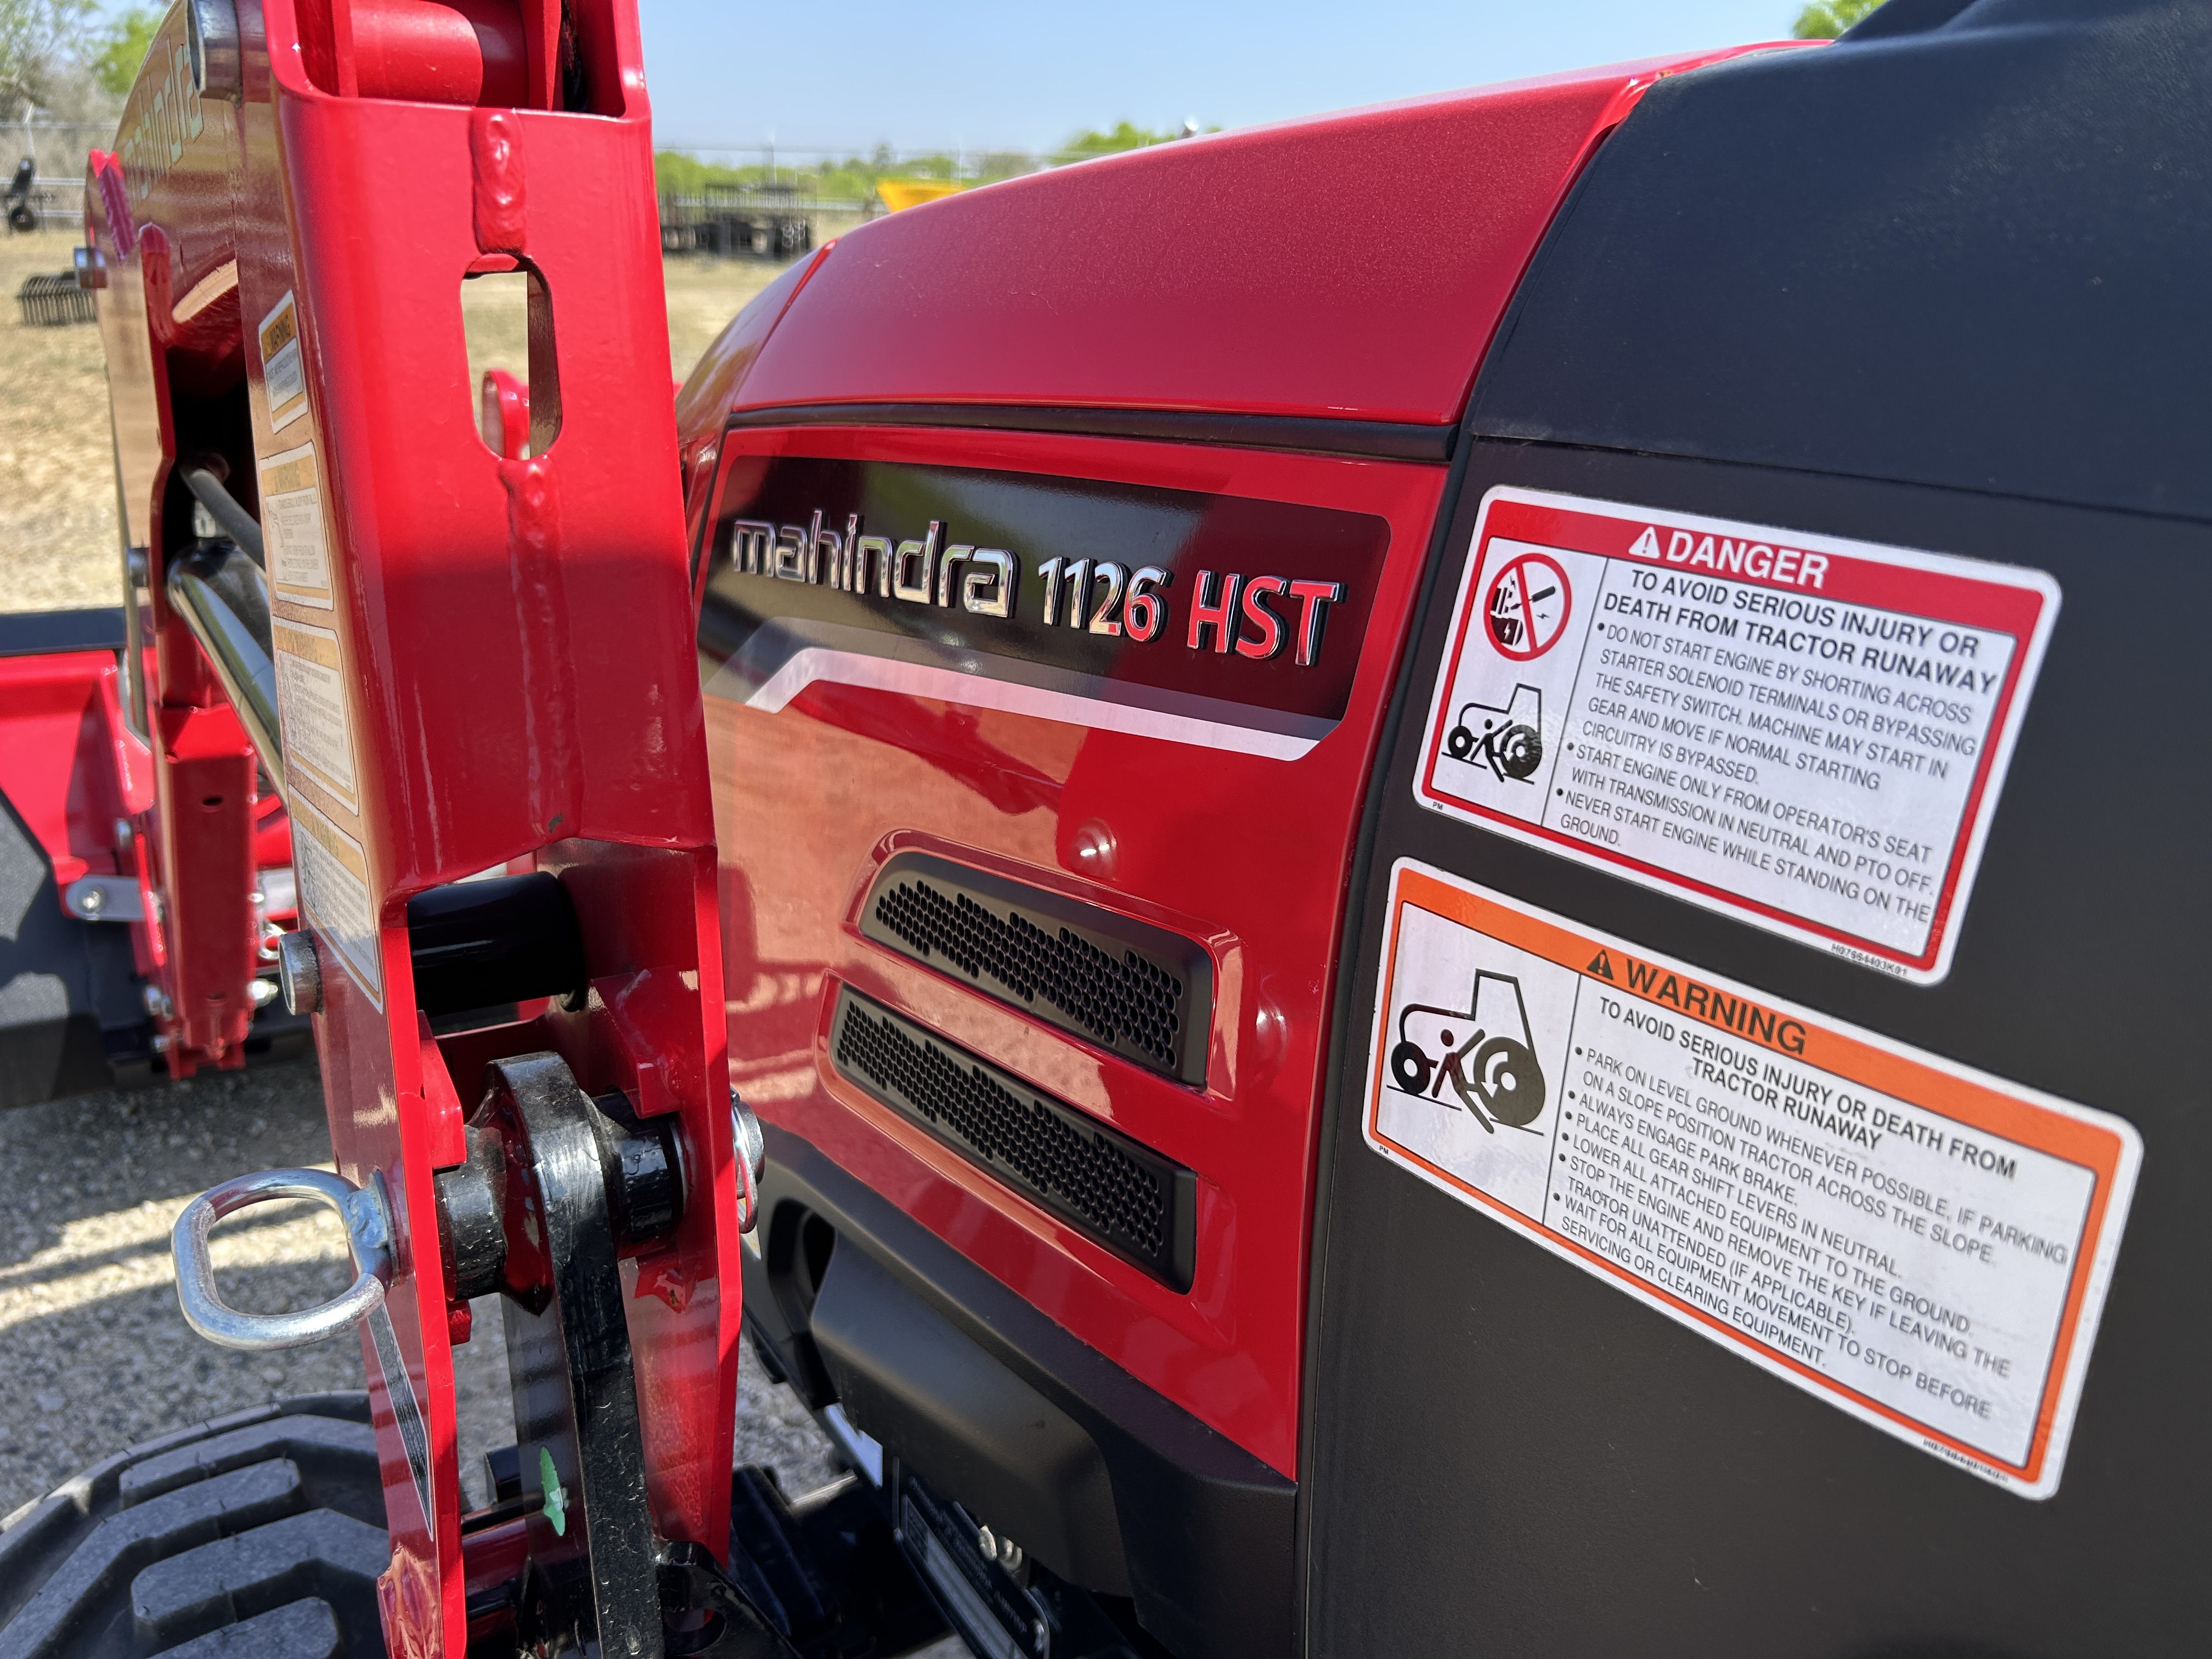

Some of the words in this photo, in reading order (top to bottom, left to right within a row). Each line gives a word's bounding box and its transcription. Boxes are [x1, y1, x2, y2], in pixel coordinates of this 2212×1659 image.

[732, 509, 1016, 618] mahindra
[1039, 555, 1173, 642] 1126
[1187, 570, 1347, 667] HST
[1632, 569, 1657, 590] TO
[1661, 577, 1728, 605] AVOID
[1733, 590, 1835, 627] SERIOUS
[1841, 611, 1933, 646] INJURY
[1939, 631, 1978, 657] OR
[1666, 530, 1829, 588] DANGER
[1604, 592, 1671, 623] DEATH
[1675, 607, 1739, 637] FROM
[1746, 621, 1855, 663] TRACTOR
[1861, 647, 1996, 692] RUNAWAY
[1606, 624, 1627, 642] DO
[1629, 630, 1661, 649] NOT
[1662, 637, 1712, 661] START
[1713, 648, 1773, 676] ENGINE
[1776, 663, 1799, 681] BY
[1801, 669, 1890, 704] SHORTING
[1893, 691, 1971, 724] ACROSS
[1582, 720, 1657, 752] CIRCUITRY
[1658, 742, 1672, 759] IS
[1675, 746, 1759, 786] BYPASSED.
[1588, 697, 1627, 720] GEAR
[1628, 708, 1658, 728] AND
[1661, 716, 1705, 742] MOVE
[1707, 729, 1723, 744] IF
[1725, 733, 1789, 766] NORMAL
[1795, 753, 1880, 789] STARTING
[1596, 673, 1622, 693] THE
[1623, 680, 1679, 707] SAFETY
[1681, 695, 1743, 725] SWITCH.
[1747, 712, 1821, 745] MACHINE
[1825, 732, 1863, 754] MAY
[1866, 743, 1925, 770] START
[1929, 759, 1947, 778] IN
[1600, 648, 1664, 678] STARTER
[1667, 664, 1743, 696] SOLENOID
[1749, 684, 1839, 721] TERMINALS
[1842, 707, 1869, 729] OR
[1872, 714, 1975, 755] BYPASSING
[1432, 802, 1443, 810] PM
[1565, 790, 1611, 817] NEVER
[1613, 806, 1660, 832] START
[1662, 821, 1718, 853] ENGINE
[1723, 841, 1770, 871] WHILE
[1774, 858, 1859, 899] STANDING
[1864, 888, 1890, 909] ON
[1898, 897, 1930, 922] THE
[1572, 767, 1605, 790] WITH
[1609, 778, 1714, 825] TRANSMISSION
[1718, 814, 1732, 831] IN
[1740, 819, 1808, 856] NEUTRAL
[1814, 844, 1850, 867] AND
[1854, 855, 1891, 880] PTO
[1894, 868, 1933, 895] OFF.
[1576, 744, 1621, 768] START
[1622, 758, 1677, 787] ENGINE
[1680, 775, 1721, 798] ONLY
[1723, 787, 1769, 813] FROM
[1773, 803, 1880, 848] OPERATOR'S
[1883, 836, 1932, 862] SEAT
[1626, 958, 1805, 1055] WARNING
[1600, 996, 1620, 1019] TO
[1623, 1008, 1674, 1041] AVOID
[1679, 1030, 1757, 1076] SERIOUS
[1763, 1064, 1832, 1105] INJURY
[1837, 1094, 1866, 1121] OR
[1872, 1108, 1943, 1150] DEATH
[1949, 1138, 2015, 1177] FROM
[1694, 1057, 1778, 1109] TRACTOR
[1783, 1096, 1881, 1150] RUNAWAY
[1379, 1144, 1389, 1155] PM
[1576, 1113, 1618, 1145] PLACE
[1621, 1135, 1644, 1158] ALL
[1649, 1148, 1689, 1178] GEAR
[1691, 1168, 1734, 1198] SHIFT
[1737, 1189, 1796, 1228] LEVERS
[1801, 1219, 1817, 1238] IN
[1820, 1228, 1902, 1279] NEUTRAL.
[1579, 1093, 1633, 1128] ALWAYS
[1637, 1119, 1696, 1158] ENGAGE
[1699, 1147, 1740, 1178] PARK
[1742, 1167, 1798, 1206] BRAKE.
[1583, 1071, 1603, 1091] ON
[1605, 1081, 1613, 1097] A
[1617, 1086, 1663, 1119] SLOPE
[1666, 1107, 1735, 1150] POSITION
[1740, 1139, 1813, 1186] TRACTOR
[1815, 1176, 1886, 1217] ACROSS
[1892, 1206, 1926, 1235] THE
[1587, 1048, 1622, 1076] PARK
[1625, 1065, 1645, 1086] ON
[1649, 1075, 1691, 1107] LEVEL
[1696, 1097, 1761, 1136] GROUND
[1767, 1126, 1857, 1178] WHENEVER
[1957, 1207, 1974, 1224] IF
[1979, 1215, 2069, 1265] PARKING
[1567, 1176, 1628, 1219] TRACTOR
[1632, 1209, 1725, 1267] UNATTENDED
[1729, 1261, 1748, 1277] (IF
[1750, 1271, 1854, 1338] APPLICABLE).
[1570, 1155, 1605, 1181] STOP
[1609, 1173, 1634, 1198] THE
[1637, 1188, 1690, 1226] ENGINE
[1692, 1217, 1723, 1242] AND
[1727, 1233, 1792, 1277] REMOVE
[1797, 1266, 1828, 1295] THE
[1831, 1284, 1866, 1310] KEY
[1869, 1301, 1885, 1318] IF
[1889, 1311, 1966, 1358] LEAVING
[1974, 1348, 2009, 1376] THE
[1573, 1134, 1620, 1169] LOWER
[1622, 1159, 1646, 1182] ALL
[1650, 1173, 1726, 1219] ATTACHED
[1730, 1210, 1821, 1264] EQUIPMENT
[1825, 1254, 1847, 1277] TO
[1853, 1267, 1884, 1296] THE
[1561, 1216, 1630, 1263] SERVICING
[1634, 1255, 1654, 1276] OR
[1657, 1267, 1728, 1316] CLEARING
[1732, 1306, 1826, 1367] EQUIPMENT.
[1565, 1194, 1596, 1221] WAIT
[1599, 1212, 1626, 1239] FOR
[1628, 1229, 1652, 1253] ALL
[1657, 1243, 1741, 1296] EQUIPMENT
[1743, 1287, 1833, 1342] MOVEMENT
[1838, 1333, 1860, 1356] TO
[1864, 1347, 1911, 1378] STOP
[1915, 1372, 1989, 1419] BEFORE
